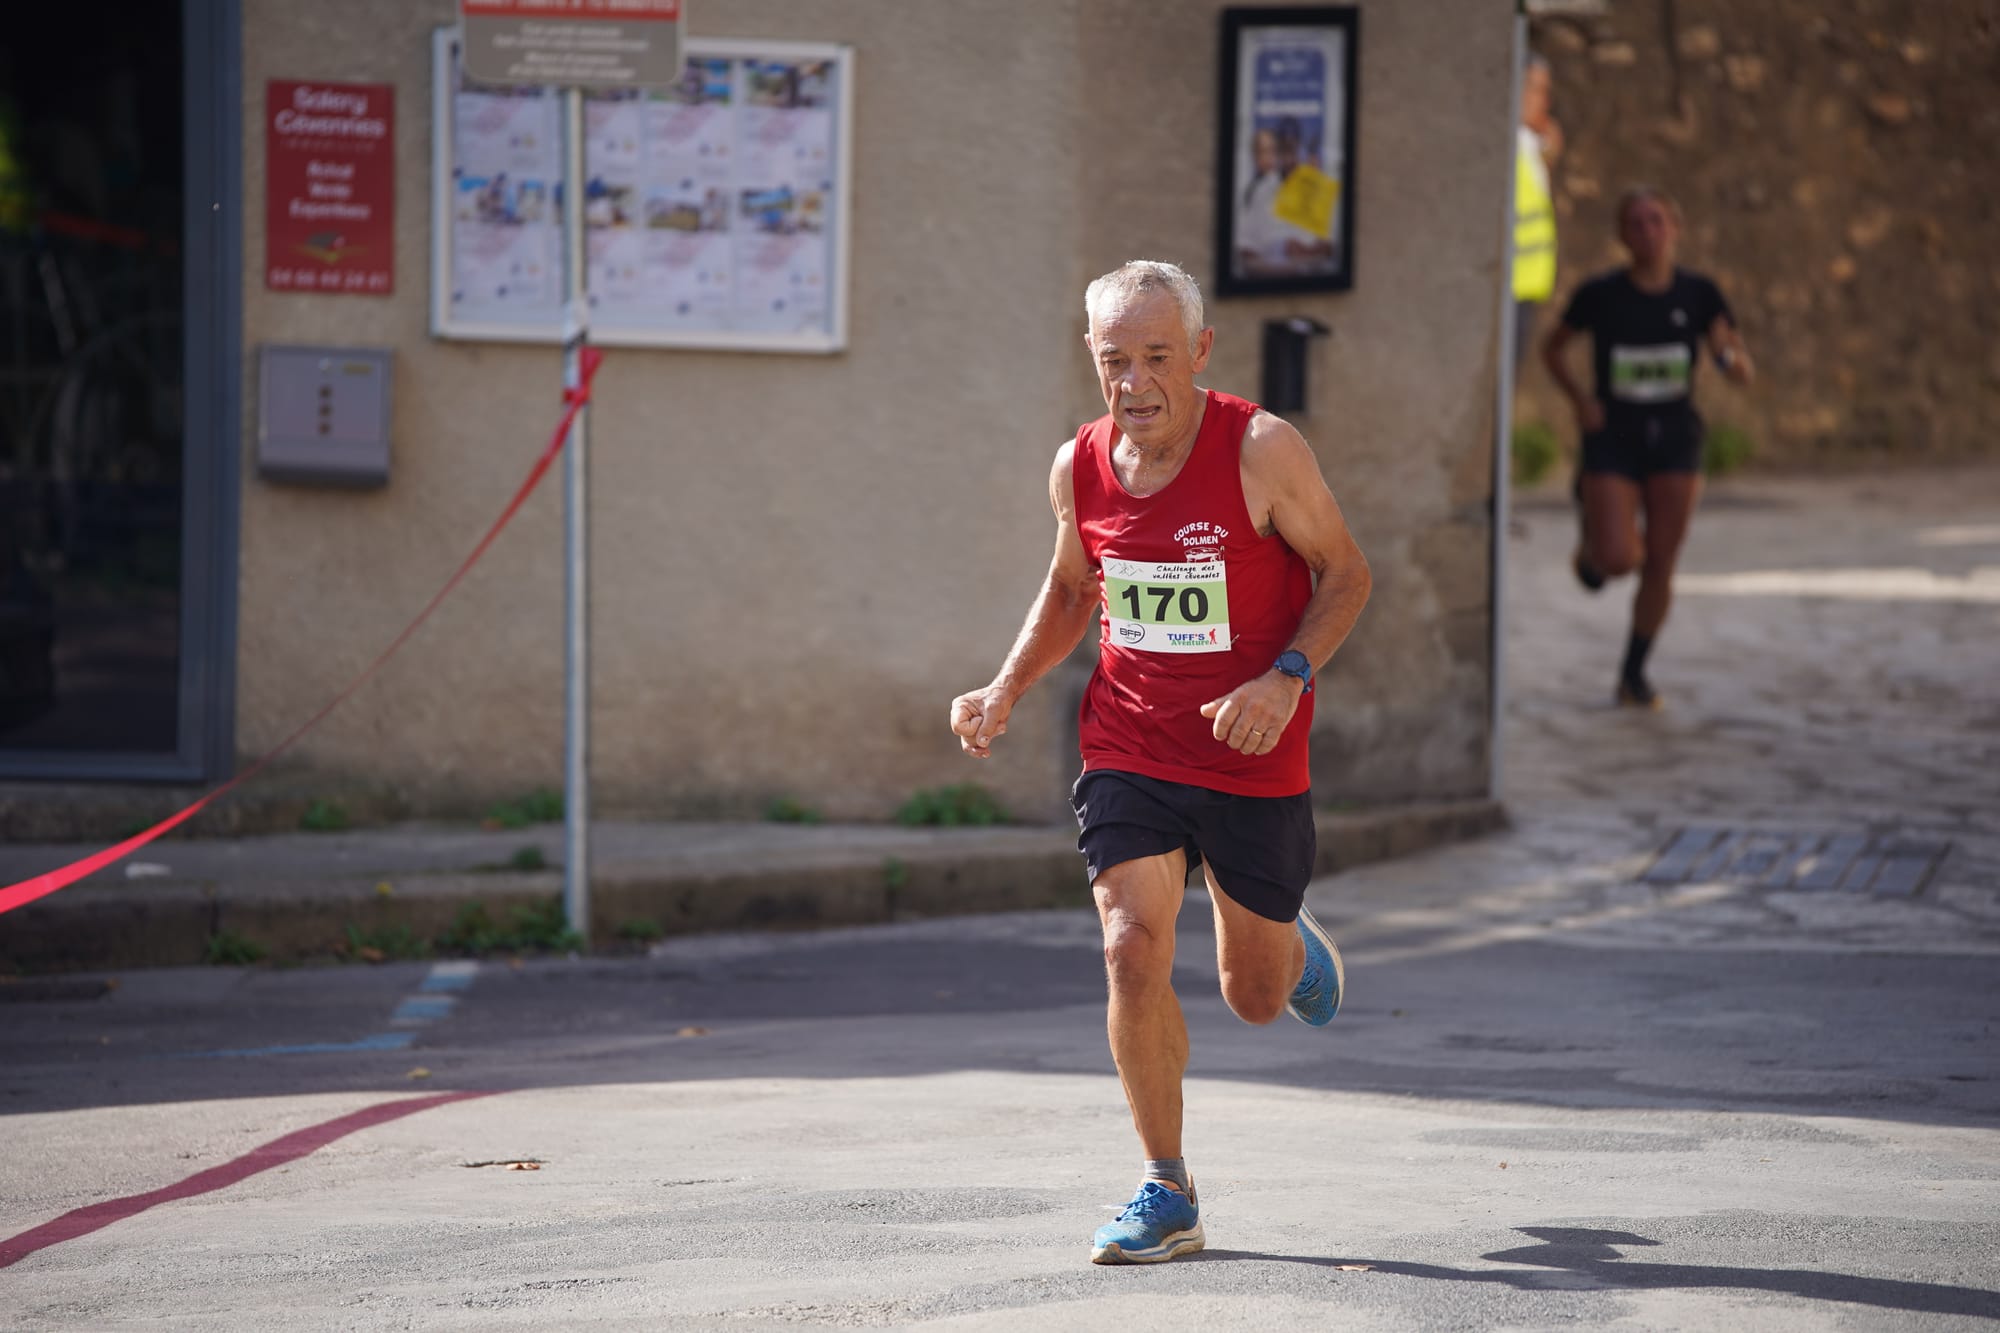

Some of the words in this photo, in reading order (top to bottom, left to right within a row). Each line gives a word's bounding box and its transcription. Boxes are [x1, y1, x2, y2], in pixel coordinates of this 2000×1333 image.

[1174, 521, 1210, 541] COURSE
[1213, 525, 1229, 538] DU
[1183, 535, 1218, 547] DOLMEN
[1156, 564, 1197, 574] Challenge
[1201, 564, 1215, 572] des
[1122, 584, 1209, 622] 170
[1167, 633, 1205, 641] TUFF'S
